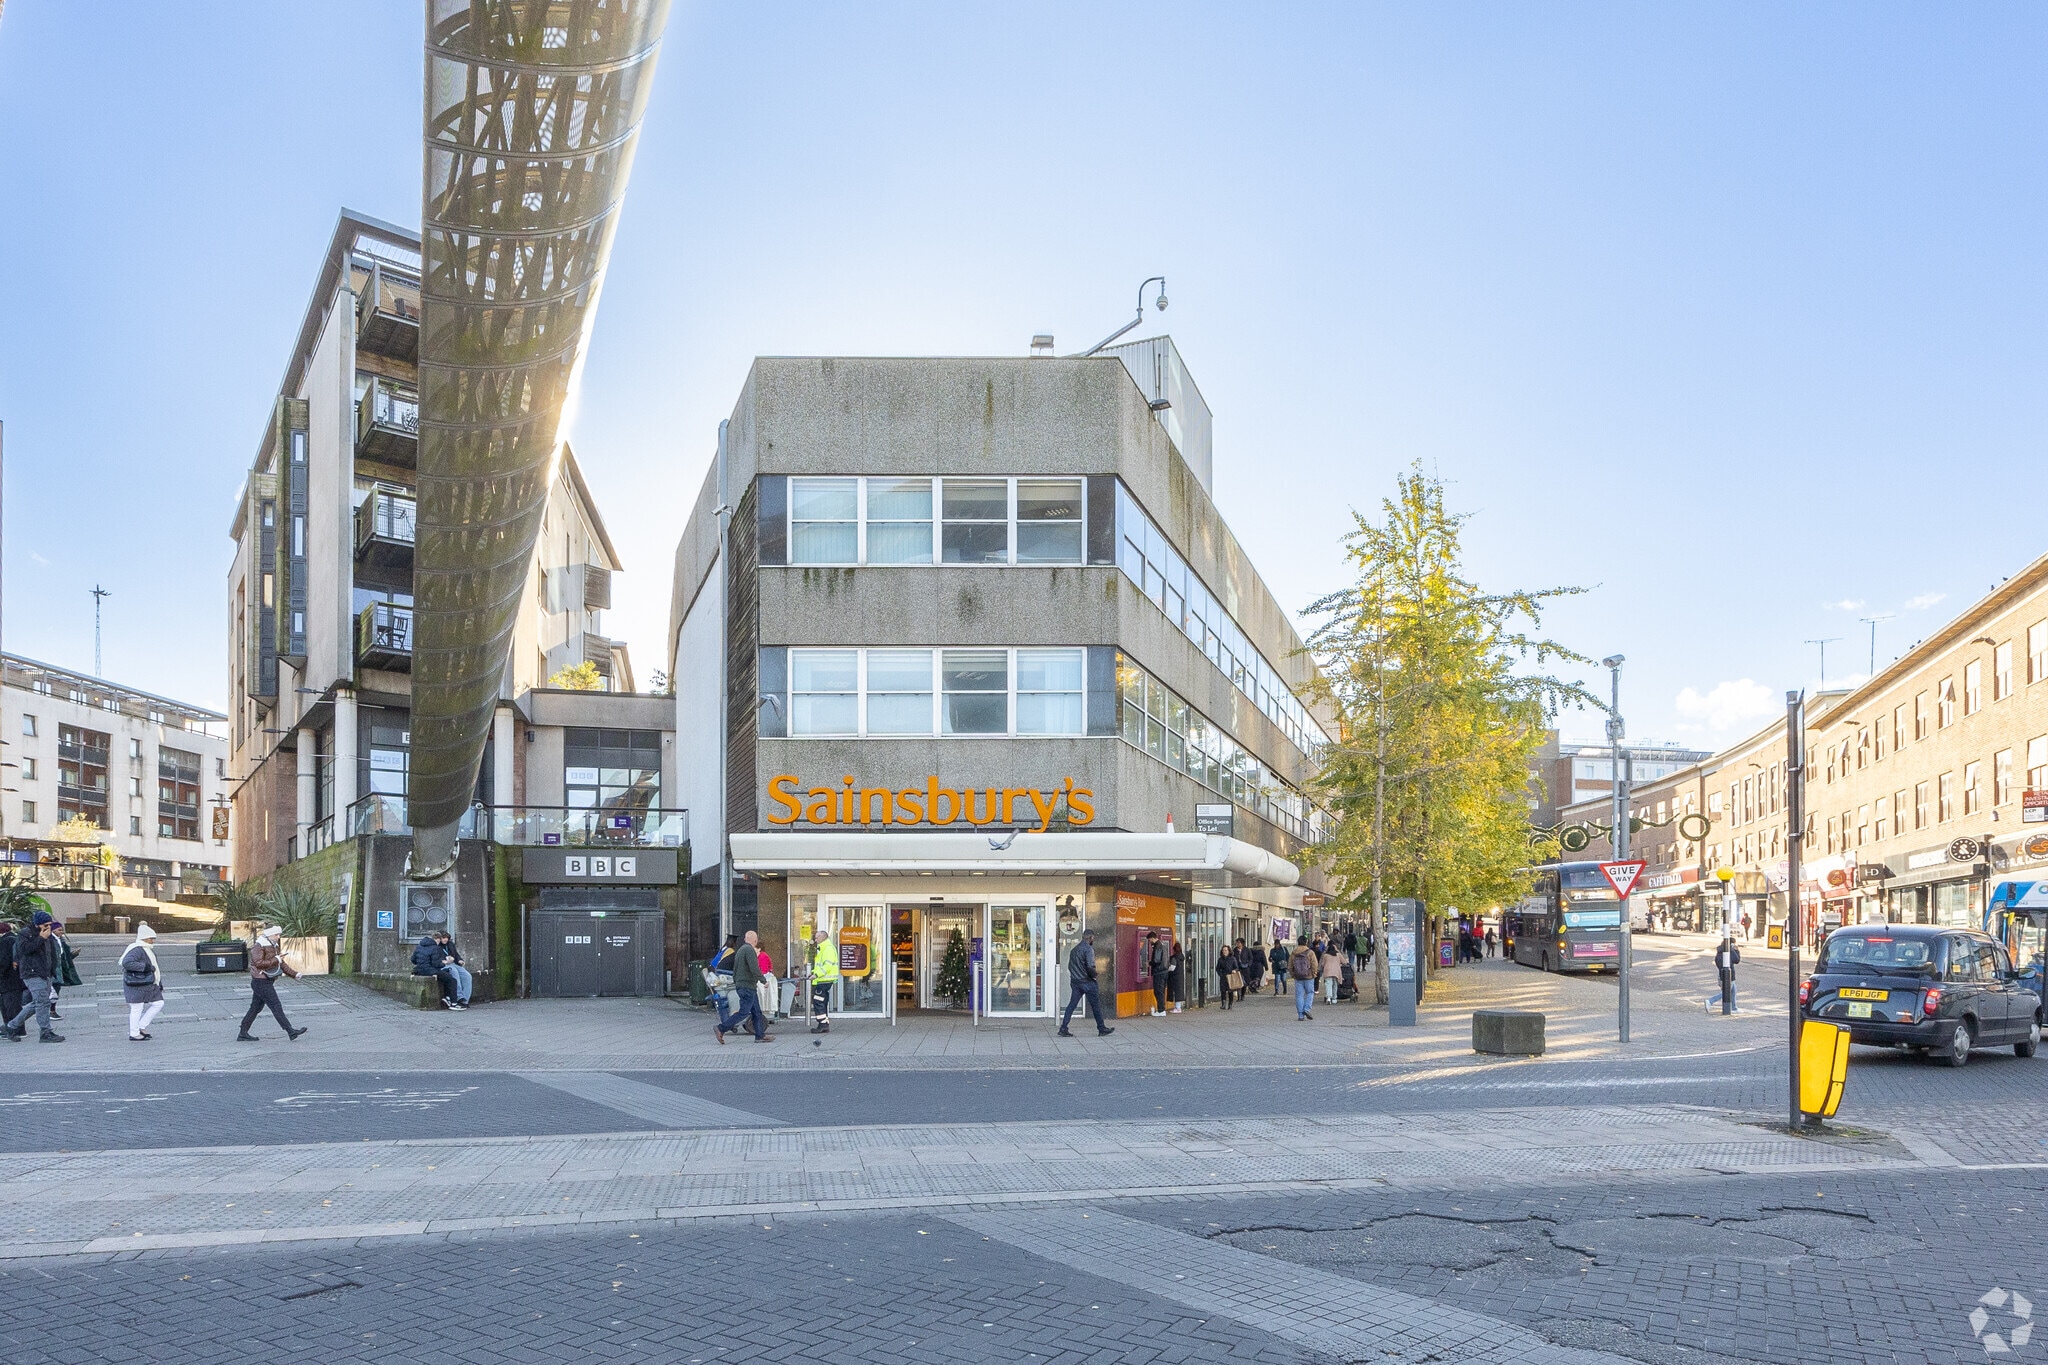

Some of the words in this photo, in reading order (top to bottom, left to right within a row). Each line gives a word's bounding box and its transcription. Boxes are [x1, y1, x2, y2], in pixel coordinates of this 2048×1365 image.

[767, 775, 1095, 833] Sainsbury's
[568, 858, 633, 874] BBC
[1609, 866, 1636, 875] GIVE
[1864, 868, 1879, 876] HD
[1844, 989, 1864, 997] LP61
[1865, 991, 1883, 999] JGF
